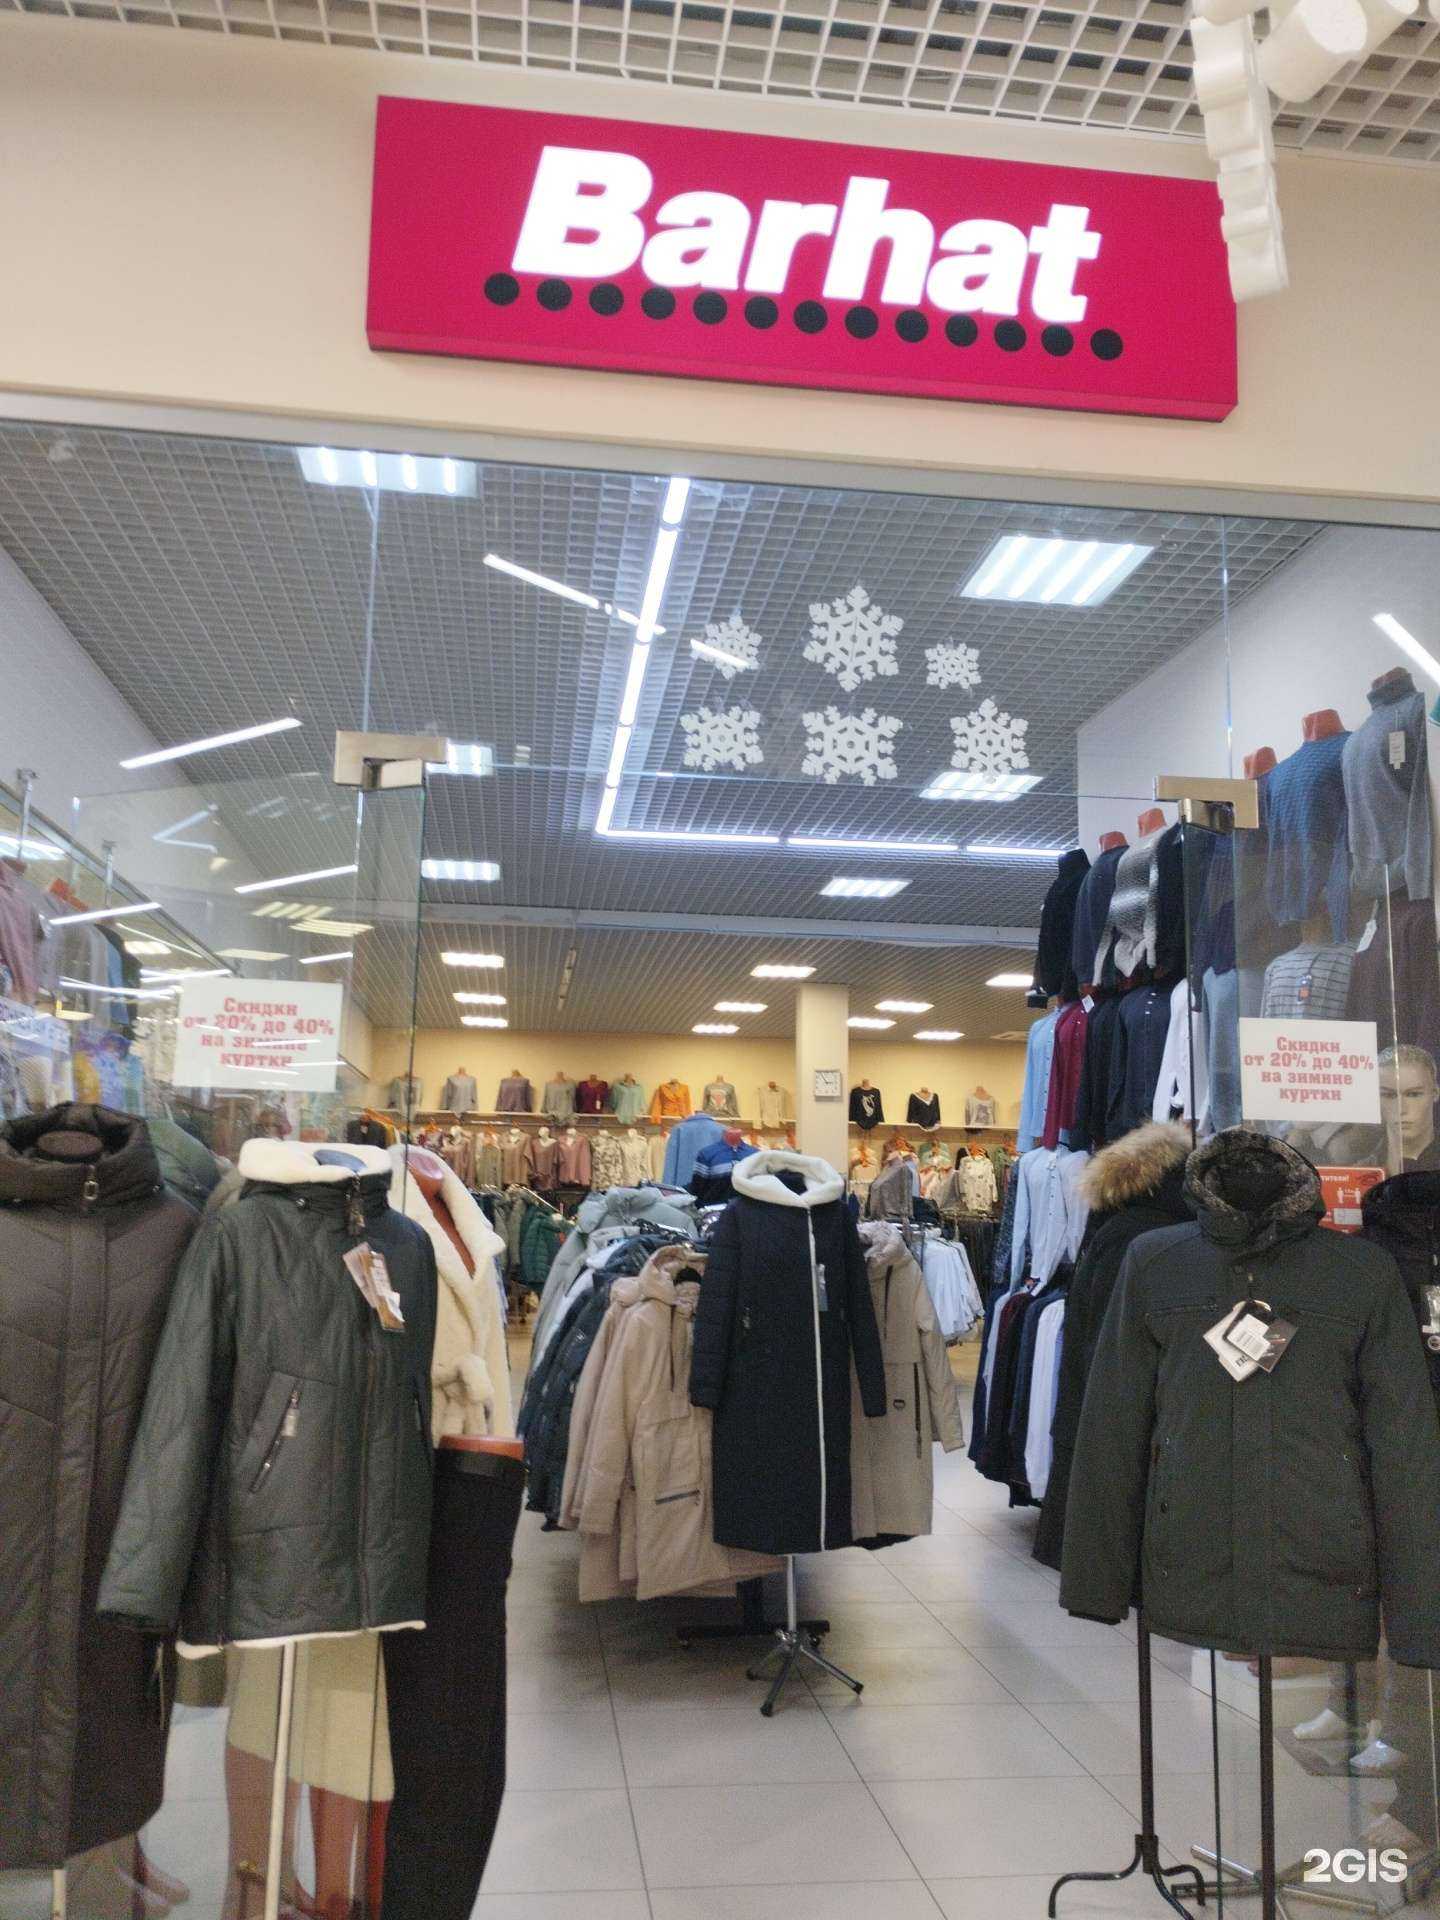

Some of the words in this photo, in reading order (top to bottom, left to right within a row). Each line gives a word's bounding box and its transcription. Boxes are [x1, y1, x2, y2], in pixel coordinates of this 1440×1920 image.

[511, 144, 1103, 323] Barhat
[223, 997, 298, 1017] Скидки
[214, 1014, 256, 1032] 20%
[263, 1020, 286, 1035] до
[294, 1018, 334, 1036] 40%
[201, 1035, 224, 1048] на
[1276, 1036, 1340, 1054] Скидки
[1244, 1055, 1264, 1066] от
[1270, 1052, 1307, 1068] 20%
[1312, 1056, 1332, 1070] до
[1338, 1055, 1374, 1070] 40%
[1261, 1071, 1282, 1083] на
[1288, 1072, 1353, 1085] зимние
[1280, 1088, 1342, 1103] куртки
